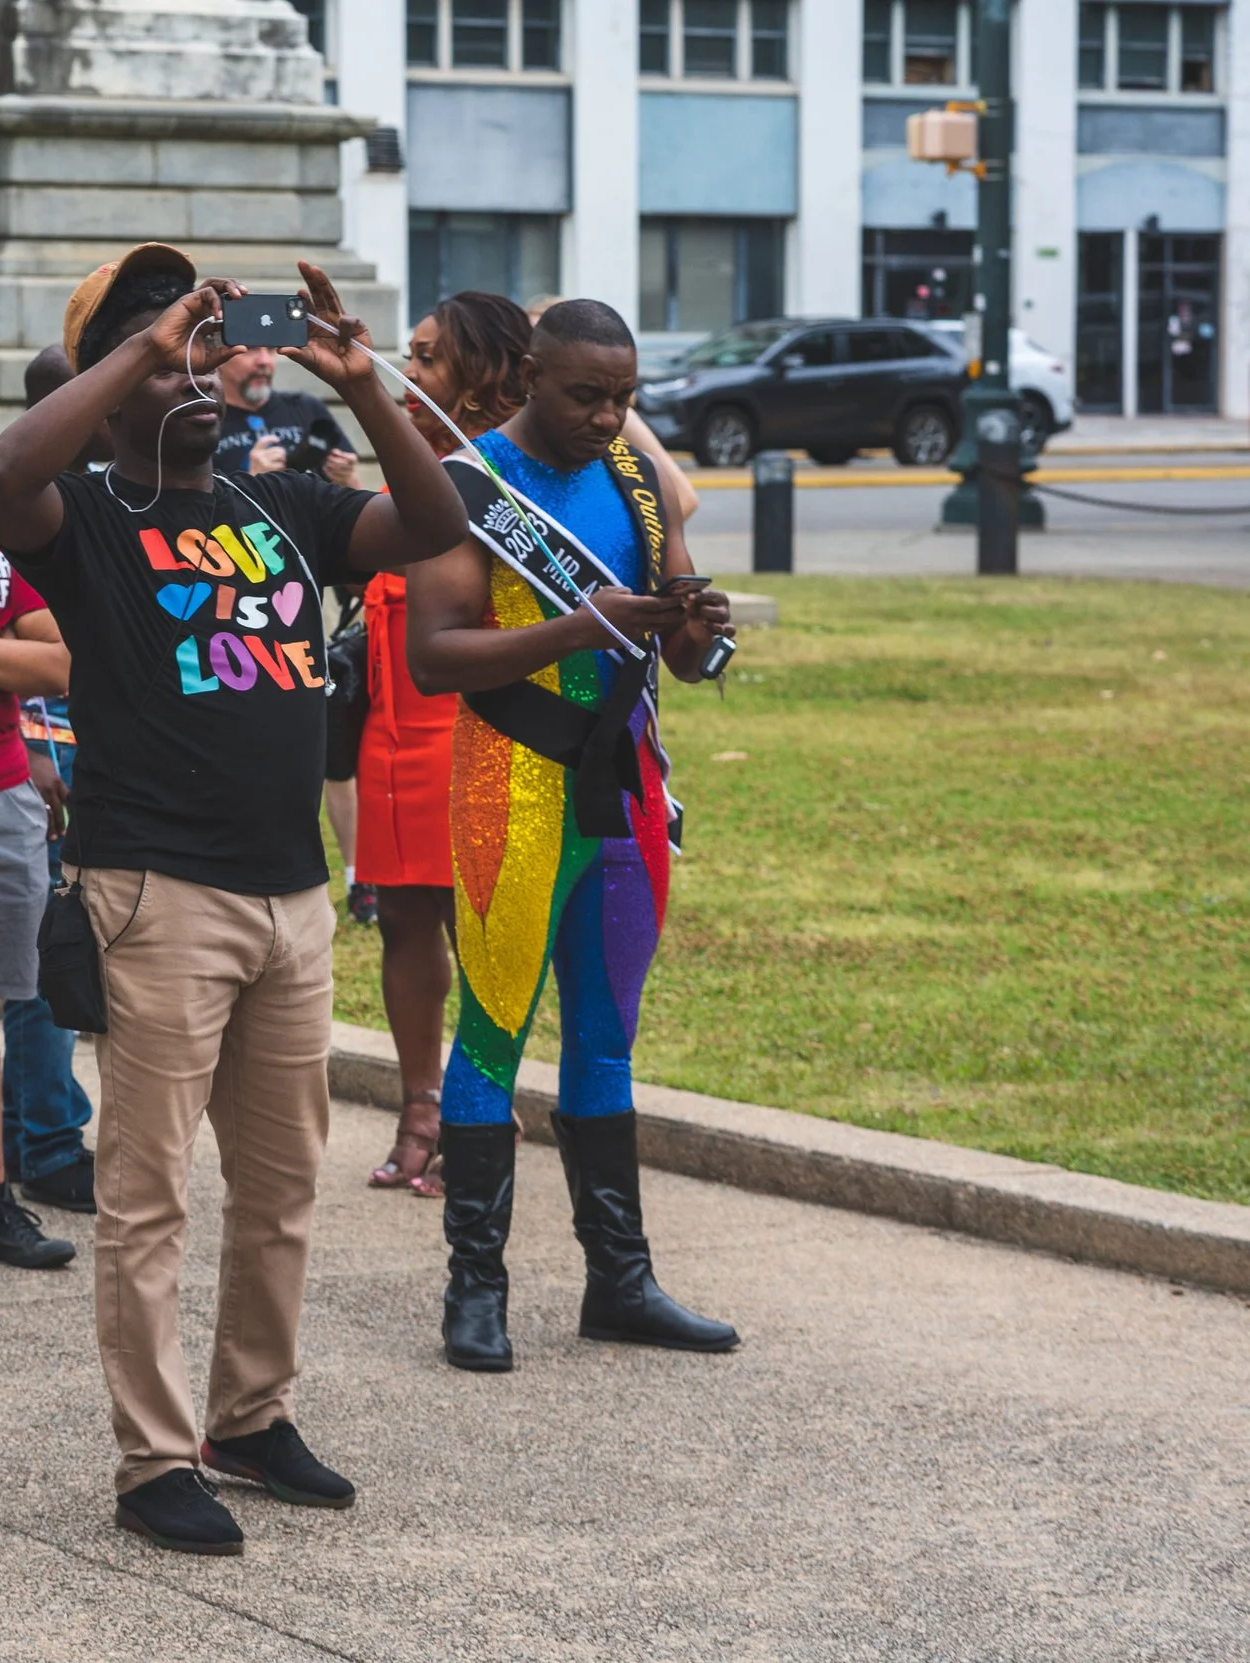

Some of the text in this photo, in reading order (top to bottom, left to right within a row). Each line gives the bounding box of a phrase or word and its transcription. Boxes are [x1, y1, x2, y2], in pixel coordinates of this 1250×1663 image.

[139, 521, 285, 583] LOVE
[504, 512, 548, 563] 2023
[176, 632, 325, 695] LOVE
